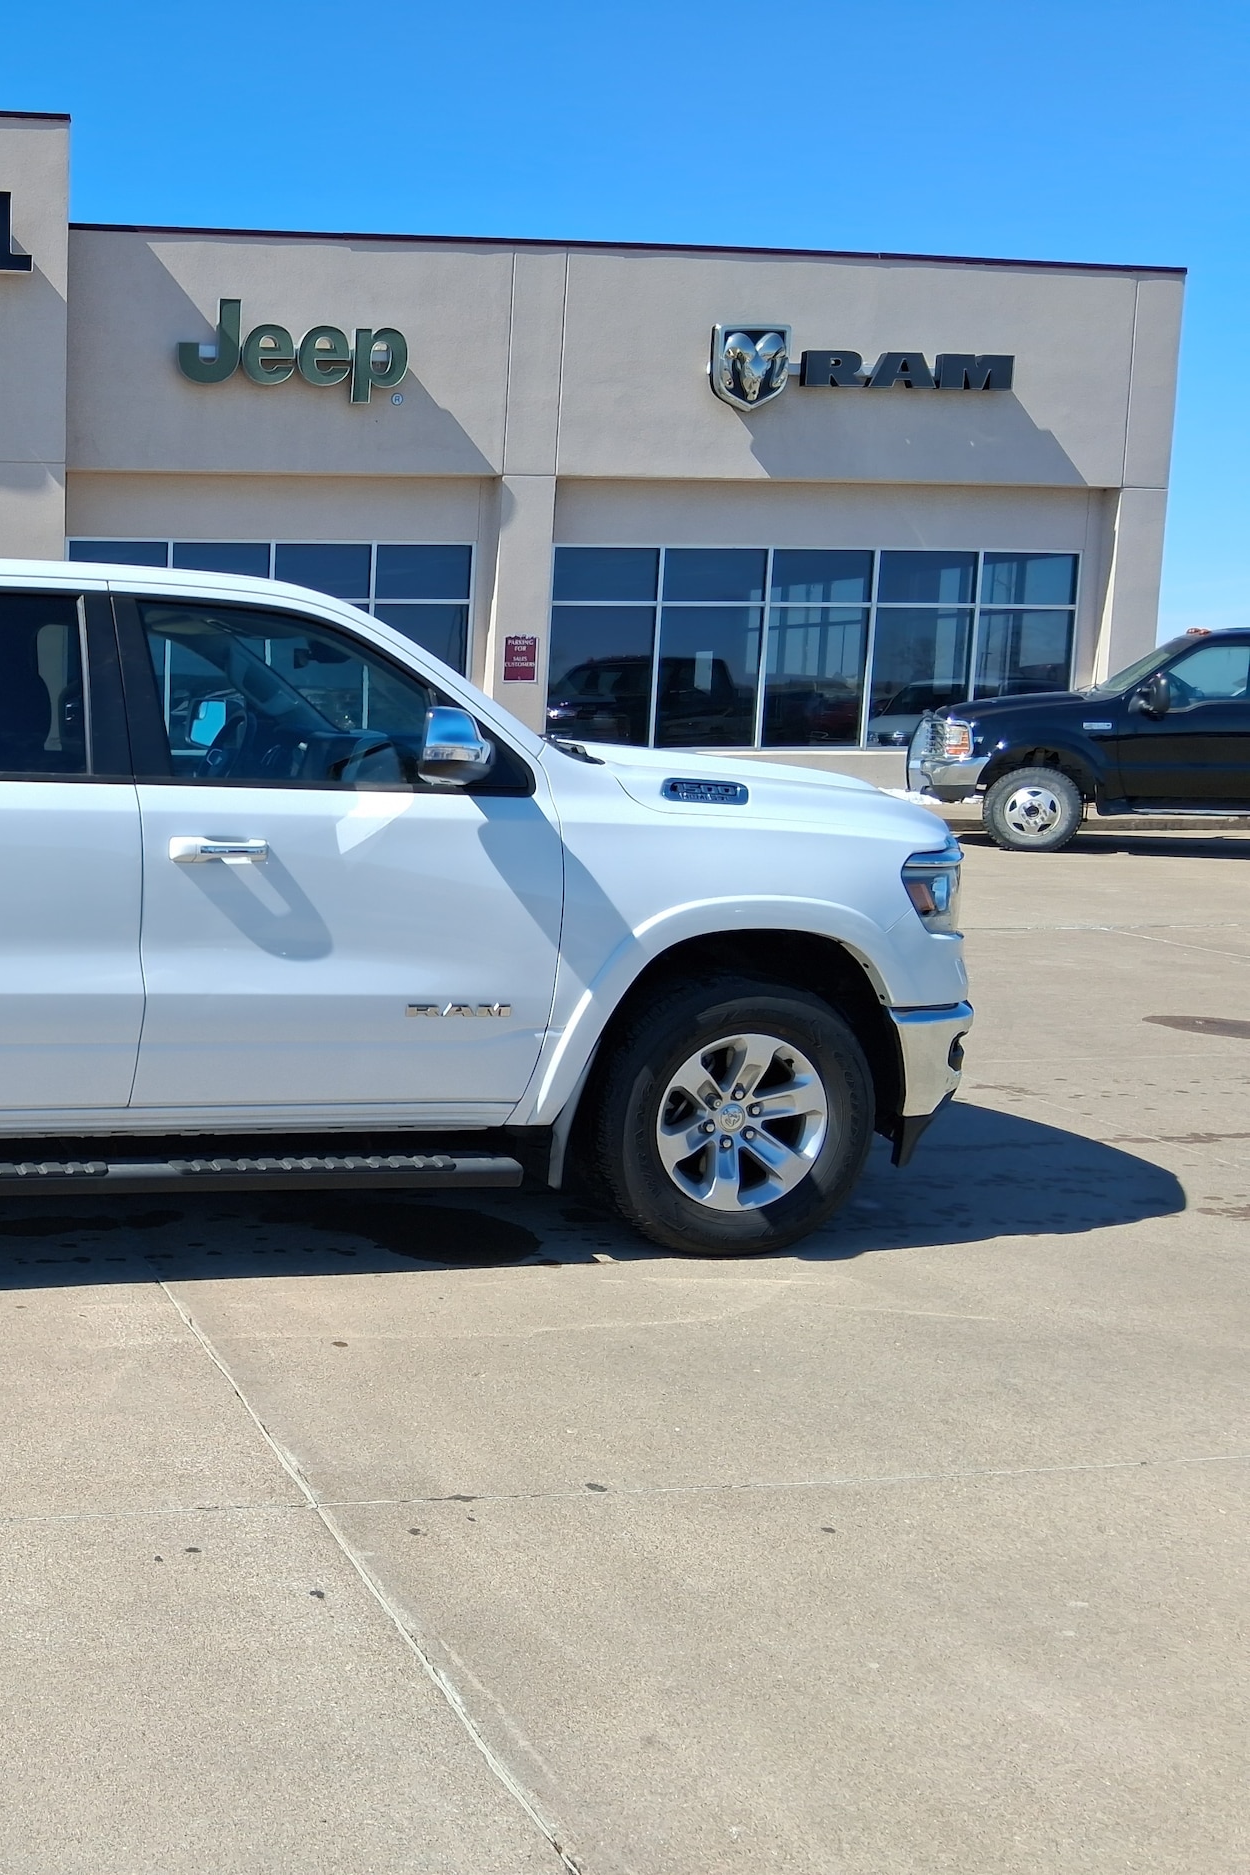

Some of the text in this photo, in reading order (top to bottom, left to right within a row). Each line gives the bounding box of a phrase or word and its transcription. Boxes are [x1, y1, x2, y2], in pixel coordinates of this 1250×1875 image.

[177, 298, 409, 403] Jeep
[800, 350, 1015, 390] RAM
[674, 782, 737, 796] 1500
[405, 1002, 511, 1017] RAM
